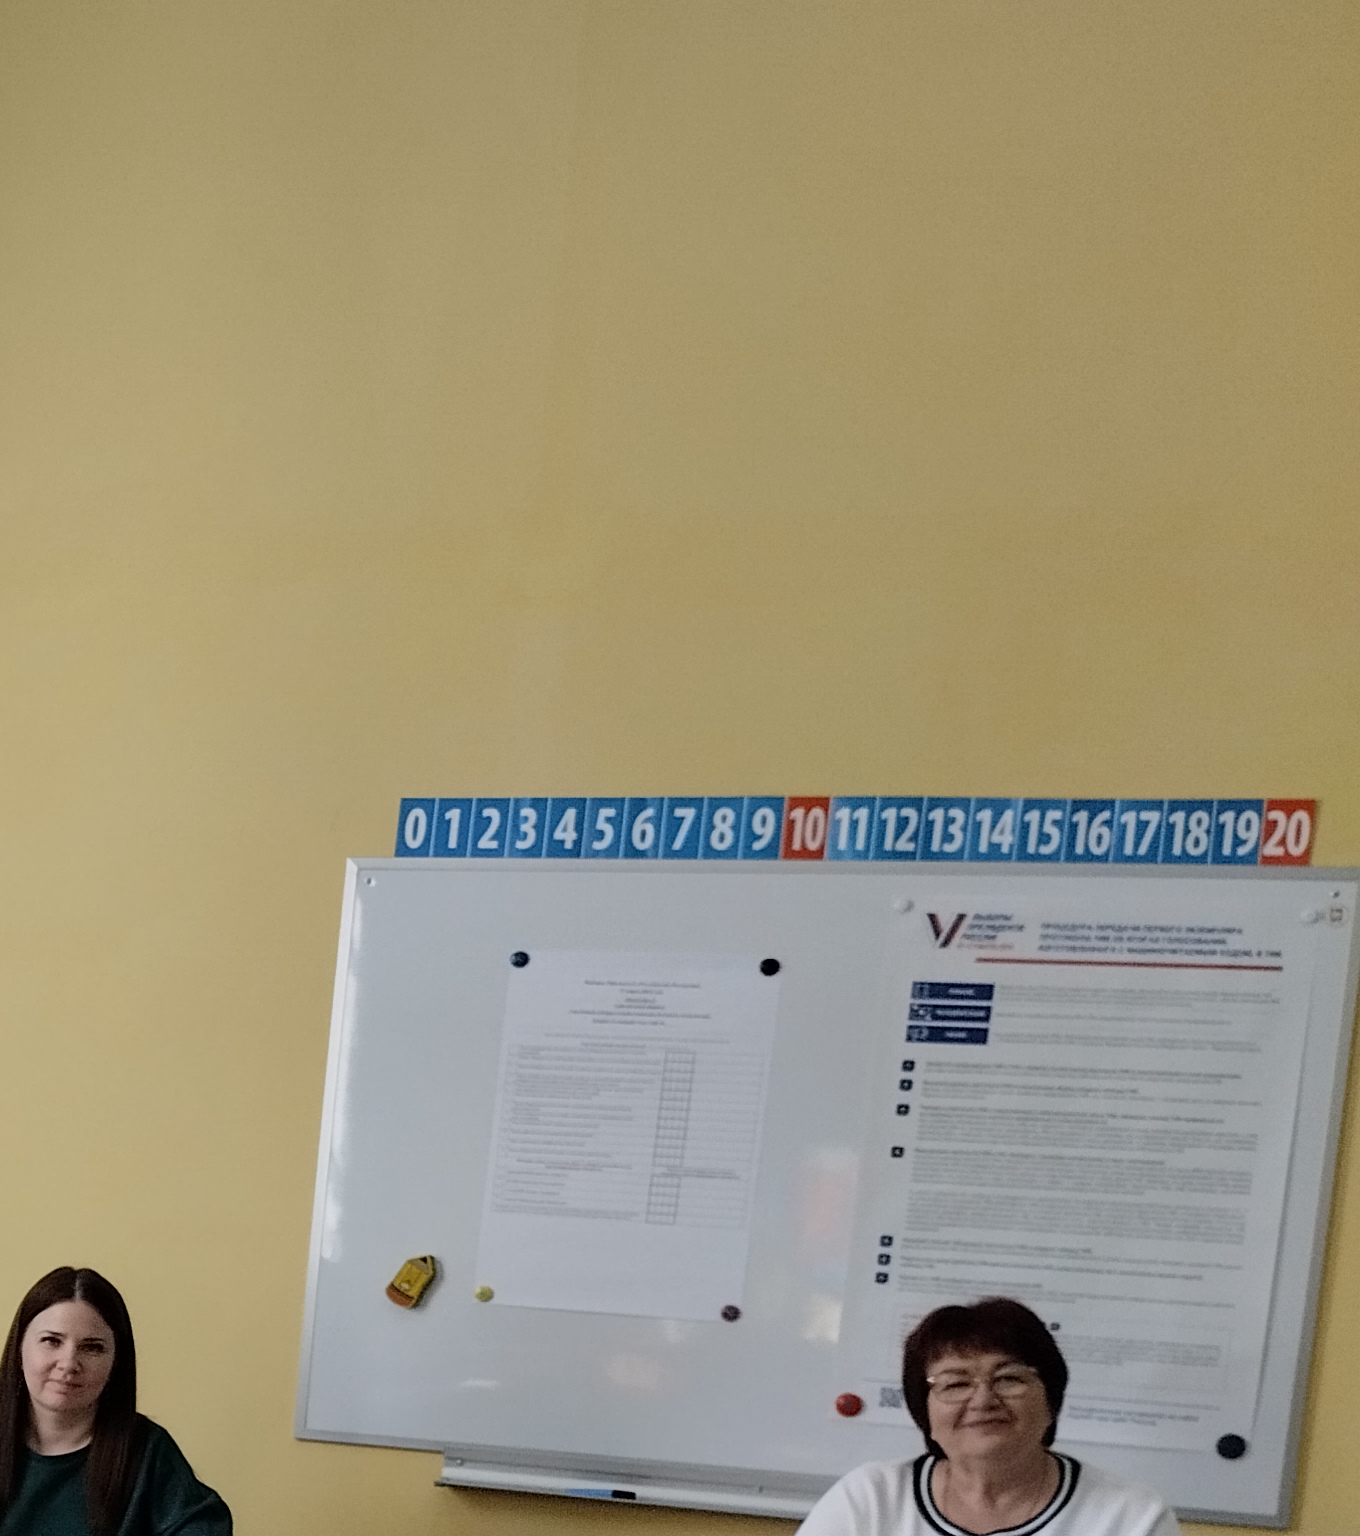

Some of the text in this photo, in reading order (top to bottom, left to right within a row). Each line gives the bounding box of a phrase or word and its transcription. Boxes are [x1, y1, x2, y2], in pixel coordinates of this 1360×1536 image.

[404, 807, 1310, 857] 0 1 2 3 4 5 6 7 8 9 10 11 12 13 14 15 16 17 18 19 20
